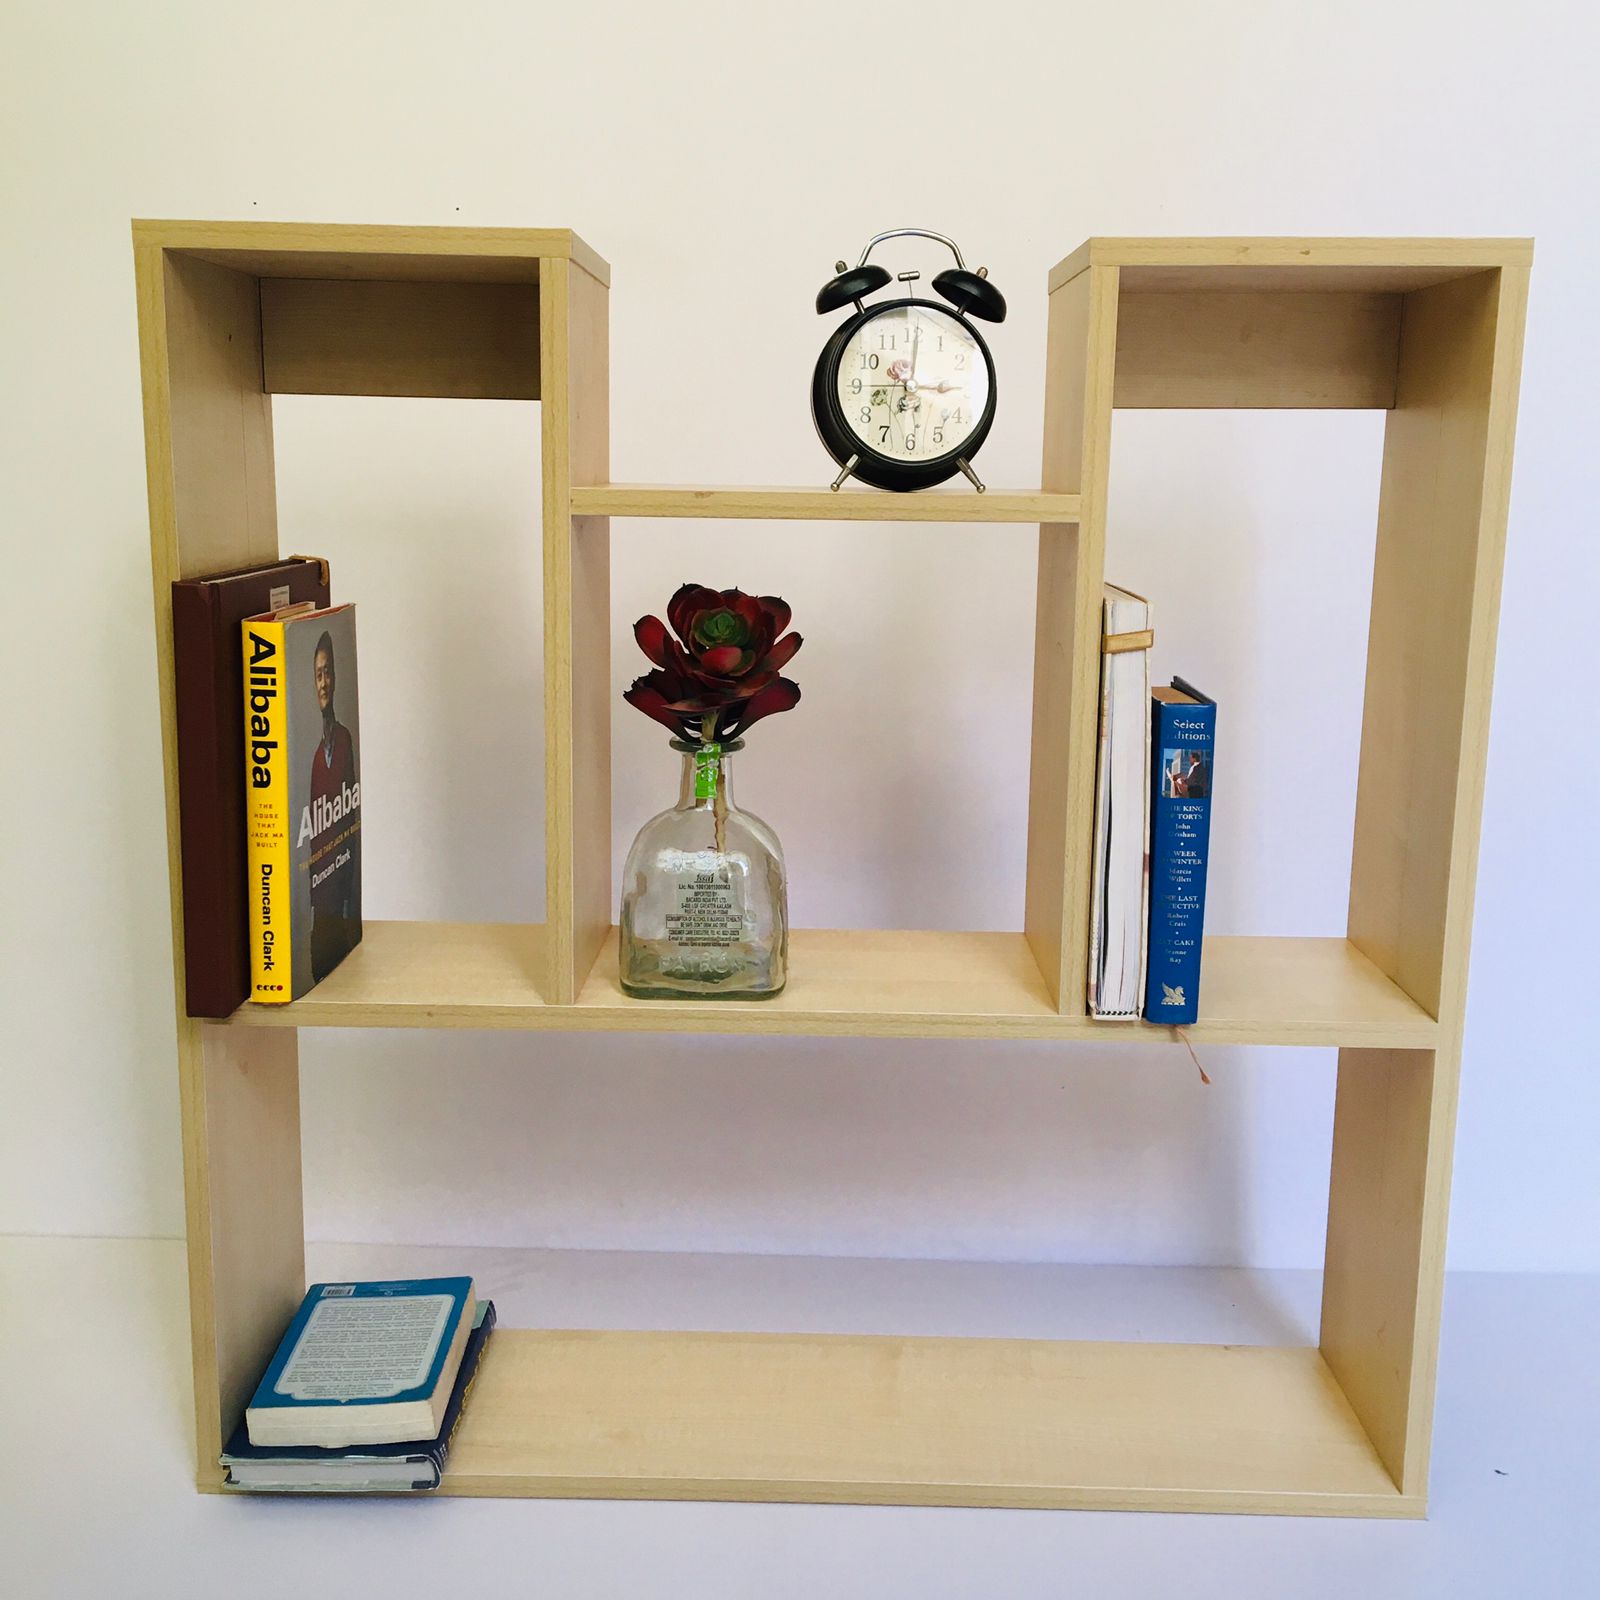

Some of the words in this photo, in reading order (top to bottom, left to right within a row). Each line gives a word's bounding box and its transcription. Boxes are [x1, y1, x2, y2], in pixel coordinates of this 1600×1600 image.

[879, 334, 897, 350] 11
[904, 328, 924, 343] 12
[937, 335, 944, 352] 1
[860, 353, 880, 370] 10
[954, 354, 965, 371] 2
[851, 378, 862, 395] 9
[860, 406, 872, 423] 8
[951, 410, 963, 424] 4
[878, 425, 890, 443] 7
[905, 433, 916, 451] 6
[933, 426, 943, 443] 5
[249, 631, 278, 789] Alibaba
[1173, 719, 1205, 729] Select
[1172, 730, 1210, 741] ditions
[296, 781, 361, 849] Alibaba
[312, 862, 335, 889] Duncan
[335, 848, 351, 869] Clark
[261, 864, 273, 925] Duncan
[262, 930, 276, 972] Clark
